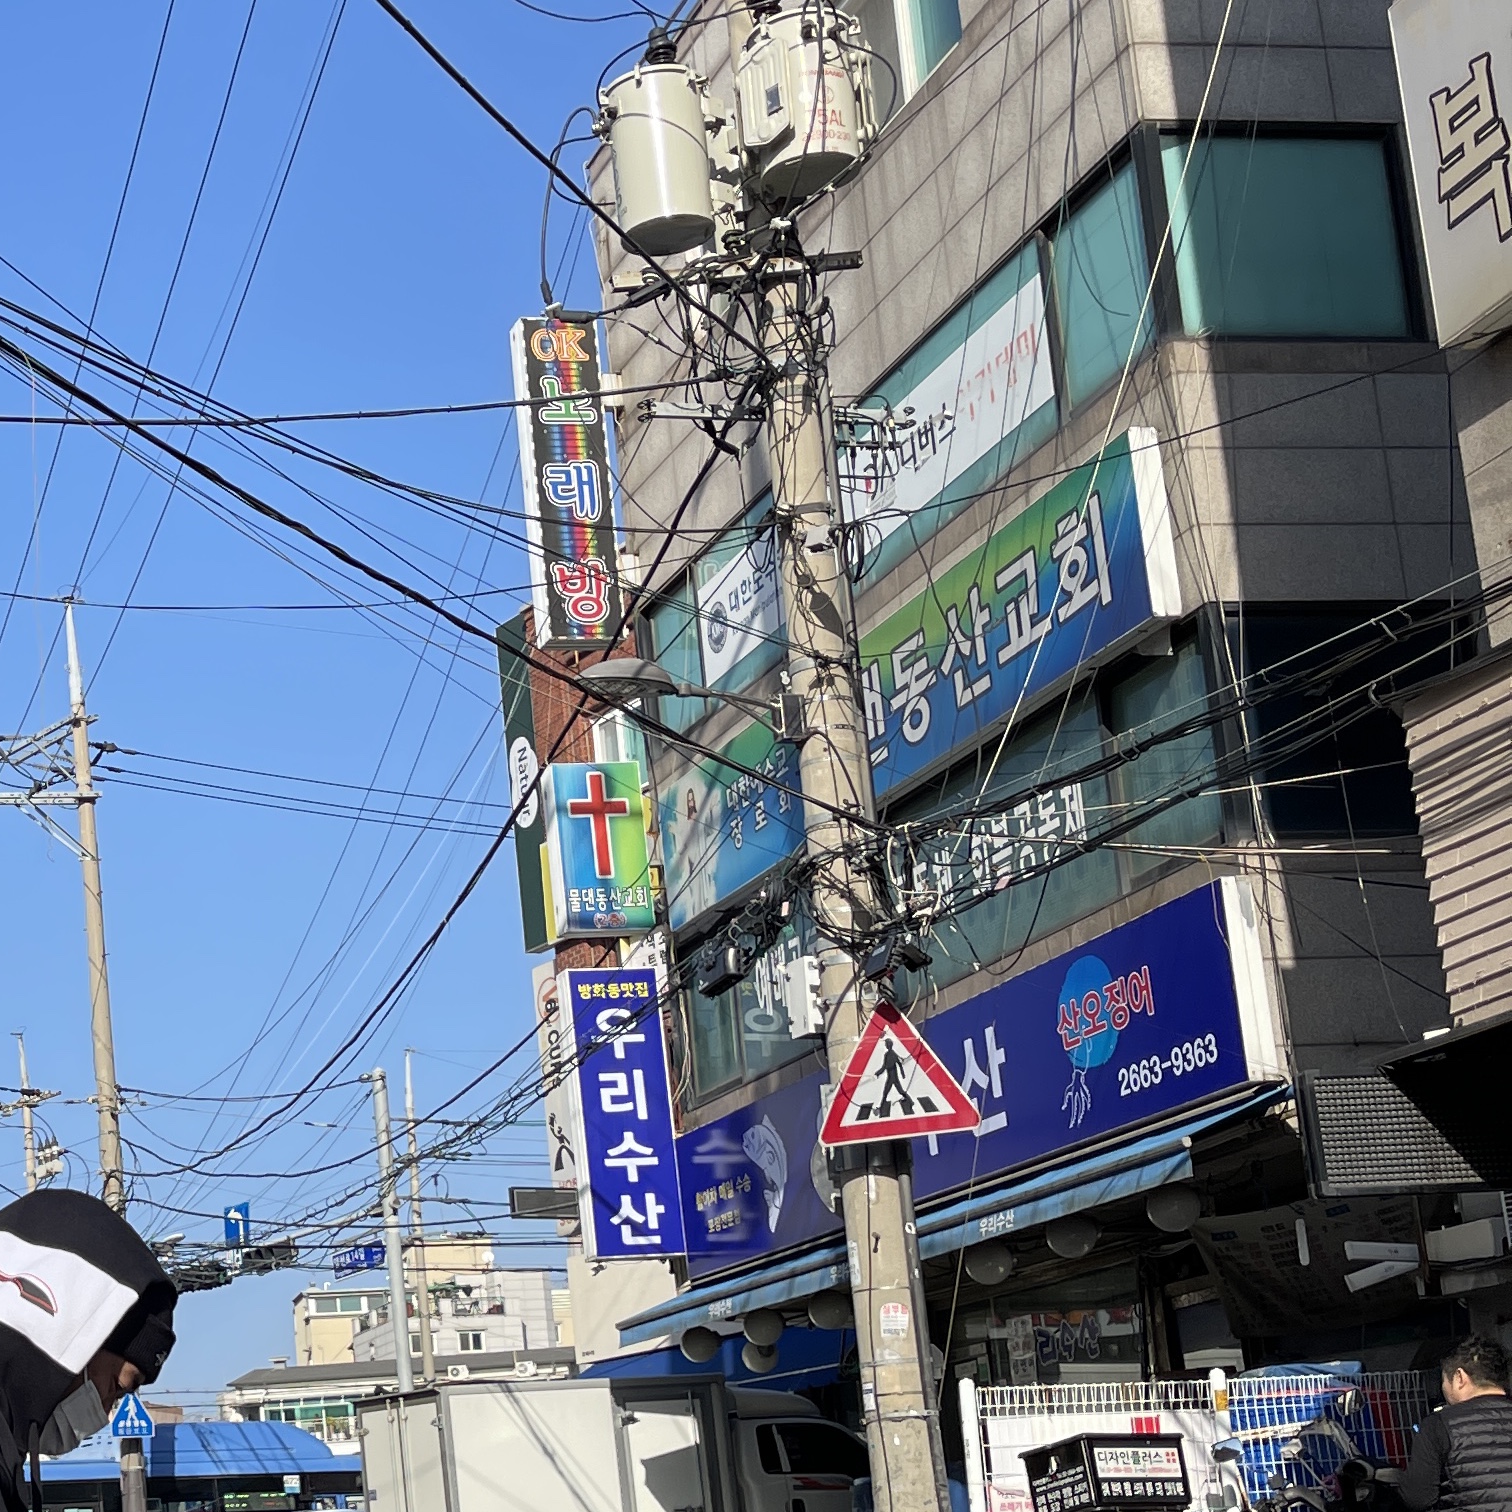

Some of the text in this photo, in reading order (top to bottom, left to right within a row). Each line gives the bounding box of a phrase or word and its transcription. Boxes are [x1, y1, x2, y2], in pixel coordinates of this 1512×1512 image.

[530, 328, 589, 362] OK
[541, 376, 612, 623] 노래방
[568, 886, 649, 912] 물댄동산교회
[578, 982, 649, 999] 방화동맛집
[1057, 965, 1155, 1050] 산오징어
[1118, 1033, 1219, 1097] 2663-9363
[592, 1008, 665, 1245] 우리수산
[979, 1209, 1015, 1234] 우리수산
[1097, 1450, 1164, 1466] 디자인플러스
